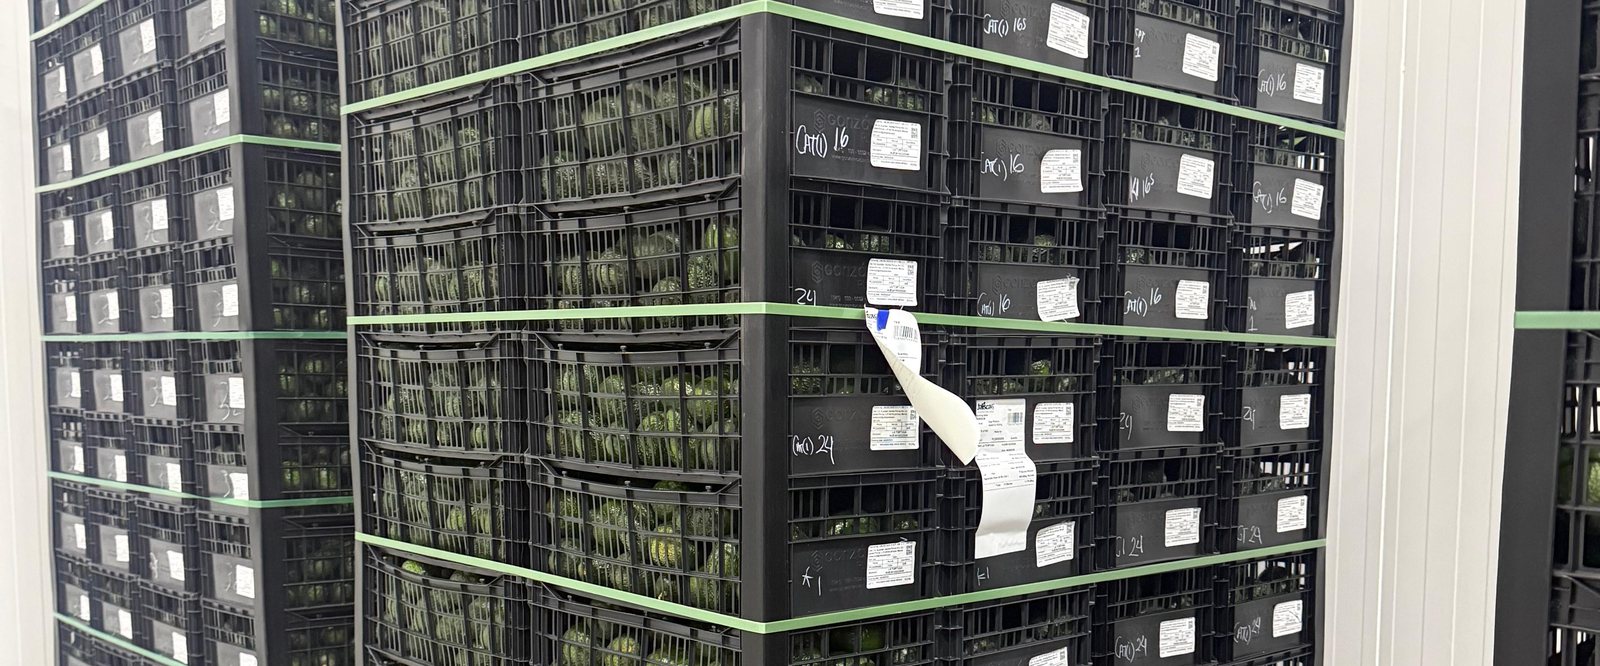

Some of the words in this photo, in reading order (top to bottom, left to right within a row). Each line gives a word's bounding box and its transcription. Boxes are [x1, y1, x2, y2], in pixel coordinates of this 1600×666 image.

[1276, 73, 1287, 92] 16
[833, 126, 849, 151] 16
[1009, 153, 1025, 174] 16
[1275, 187, 1287, 207] 16
[794, 287, 817, 307] 24
[998, 293, 1011, 315] 16
[1149, 287, 1162, 306] 16
[815, 434, 836, 465] 24
[1128, 534, 1144, 557] 24
